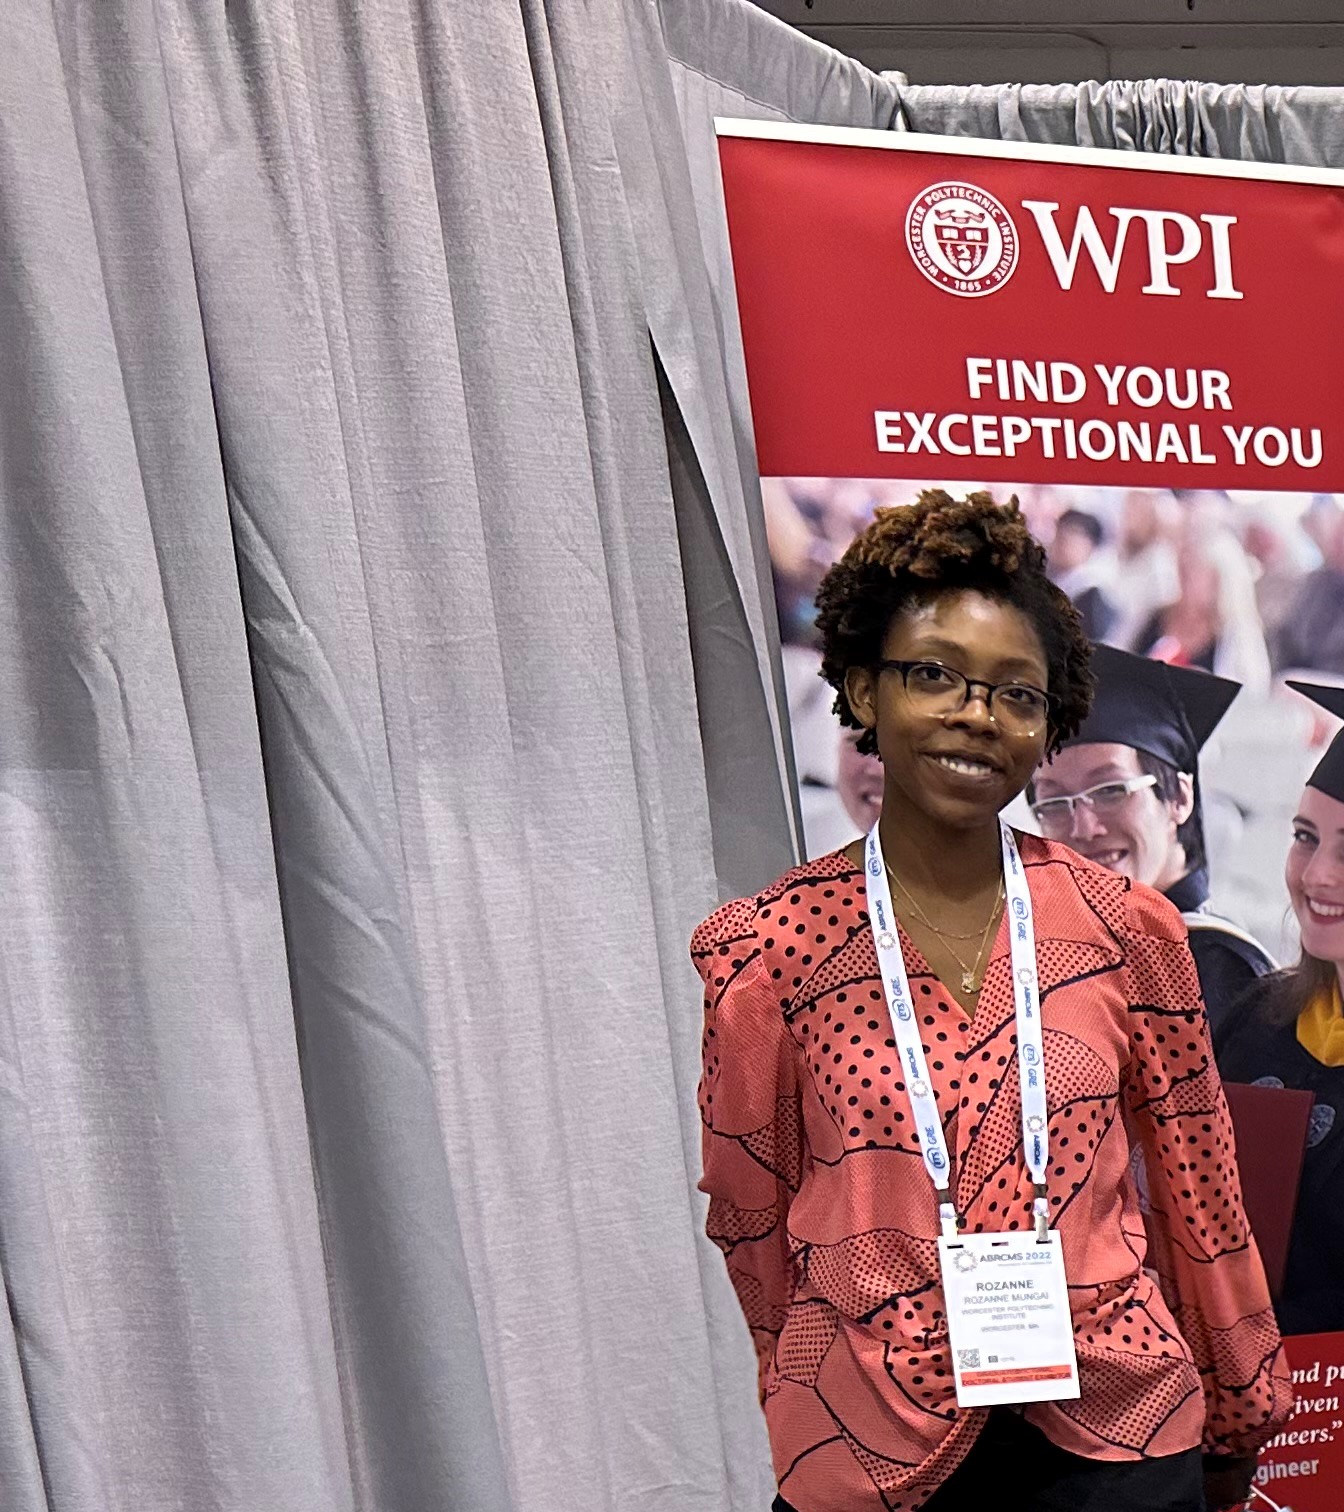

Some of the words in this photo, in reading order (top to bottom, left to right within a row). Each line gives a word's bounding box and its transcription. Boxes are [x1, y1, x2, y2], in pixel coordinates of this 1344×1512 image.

[924, 186, 1002, 219] POLYTECHNIC
[910, 205, 940, 277] WORCESTER
[990, 220, 1015, 282] INSTITUTE
[1021, 199, 1245, 300] WPI
[953, 279, 983, 292] 1865
[966, 357, 1088, 405] FIND
[1093, 363, 1234, 411] YOUR
[873, 410, 1217, 465] EXCEPTIONAL
[1221, 424, 1324, 468] YOU
[1027, 1067, 1038, 1089] GRE
[979, 1252, 1024, 1263] ABRCMS
[1025, 1251, 1052, 1261] 2022
[976, 1279, 1035, 1292] ROZANNE
[1288, 1395, 1339, 1421] iven
[1250, 1458, 1320, 1486] gineer
